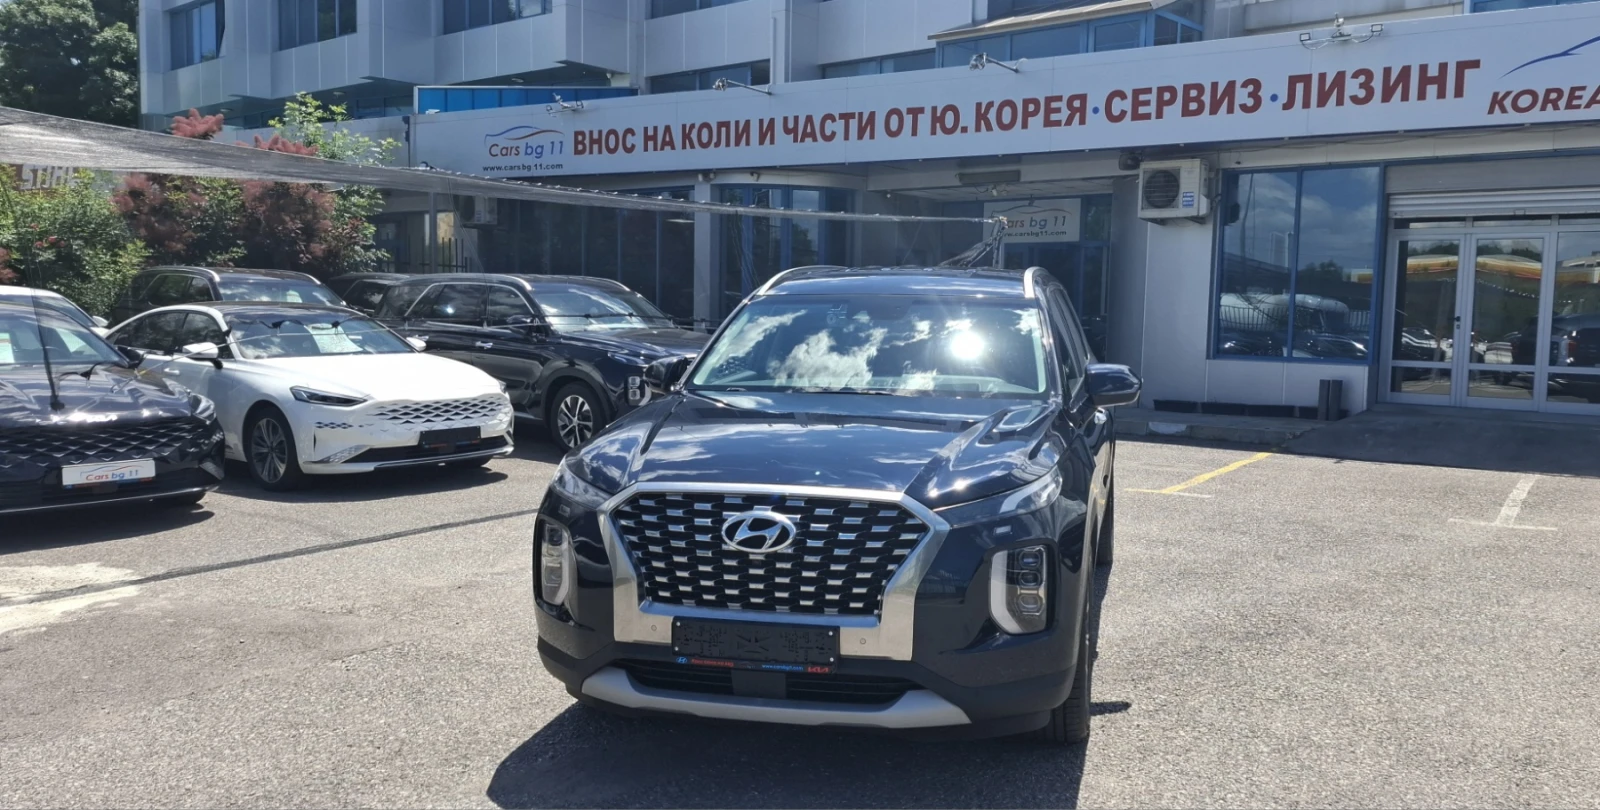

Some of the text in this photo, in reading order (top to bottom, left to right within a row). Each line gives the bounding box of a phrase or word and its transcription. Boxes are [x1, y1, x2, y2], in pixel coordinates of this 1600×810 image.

[573, 58, 1481, 156] ВНОС НА КОЛИ И ЧАСТИ ОТ Ю. КОРЕЯ СЕРВИЗ ЛИЗИНГ
[1487, 84, 1600, 115] KOREA
[488, 140, 564, 159] Cars bg 11
[1029, 216, 1048, 230] bg
[1053, 215, 1067, 227] 11
[85, 473, 109, 481] Cars
[111, 471, 125, 480] bg
